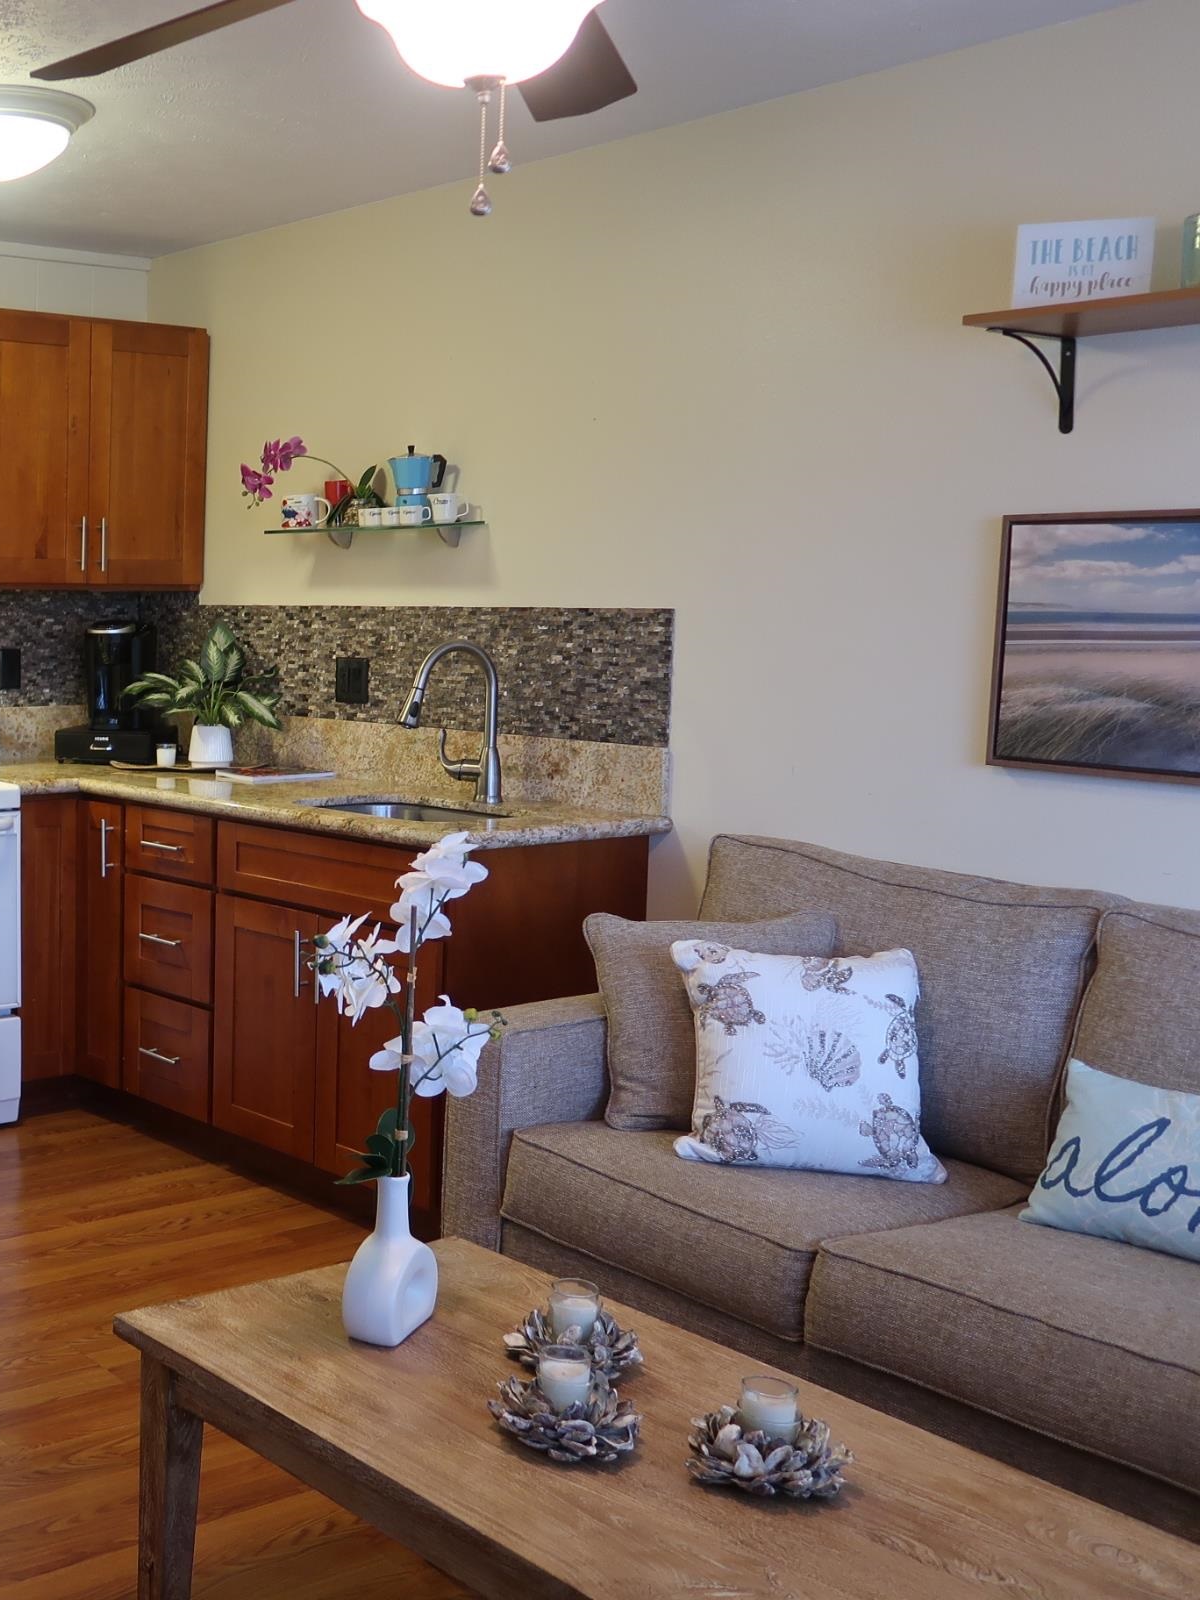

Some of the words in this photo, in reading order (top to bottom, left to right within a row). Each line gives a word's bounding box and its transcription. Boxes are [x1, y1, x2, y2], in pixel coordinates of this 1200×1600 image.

[1030, 239, 1064, 265] THE
[1072, 234, 1138, 263] BEACH
[1029, 275, 1083, 298] happy
[1086, 272, 1133, 296] place
[1040, 1116, 1200, 1234] alo
